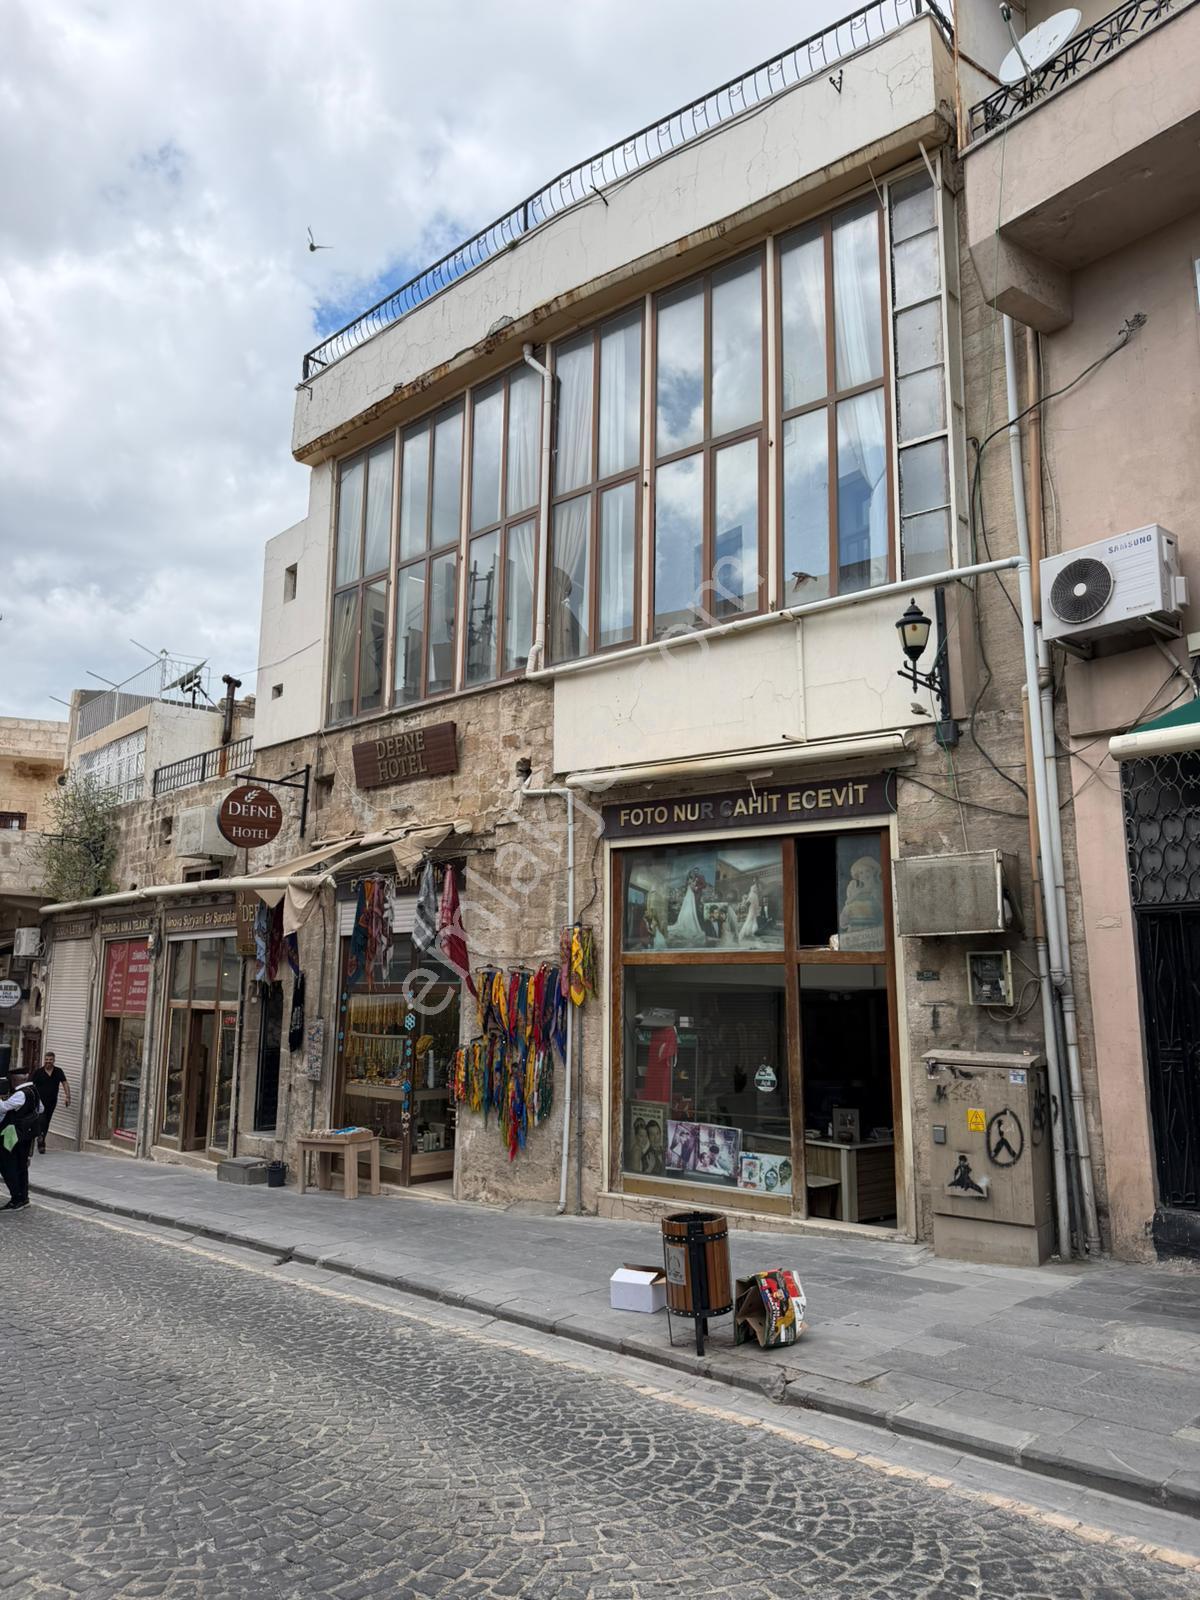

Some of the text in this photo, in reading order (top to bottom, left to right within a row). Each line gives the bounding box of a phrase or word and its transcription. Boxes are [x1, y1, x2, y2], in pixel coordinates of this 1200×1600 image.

[1108, 534, 1153, 554] SAMSUNG
[374, 730, 426, 760] DEFNE
[378, 753, 428, 782] HOTEL
[228, 800, 277, 819] DEFNE
[619, 781, 869, 828] FOTO NUR CAHİT ECEVİT
[232, 826, 271, 840] HOTEL
